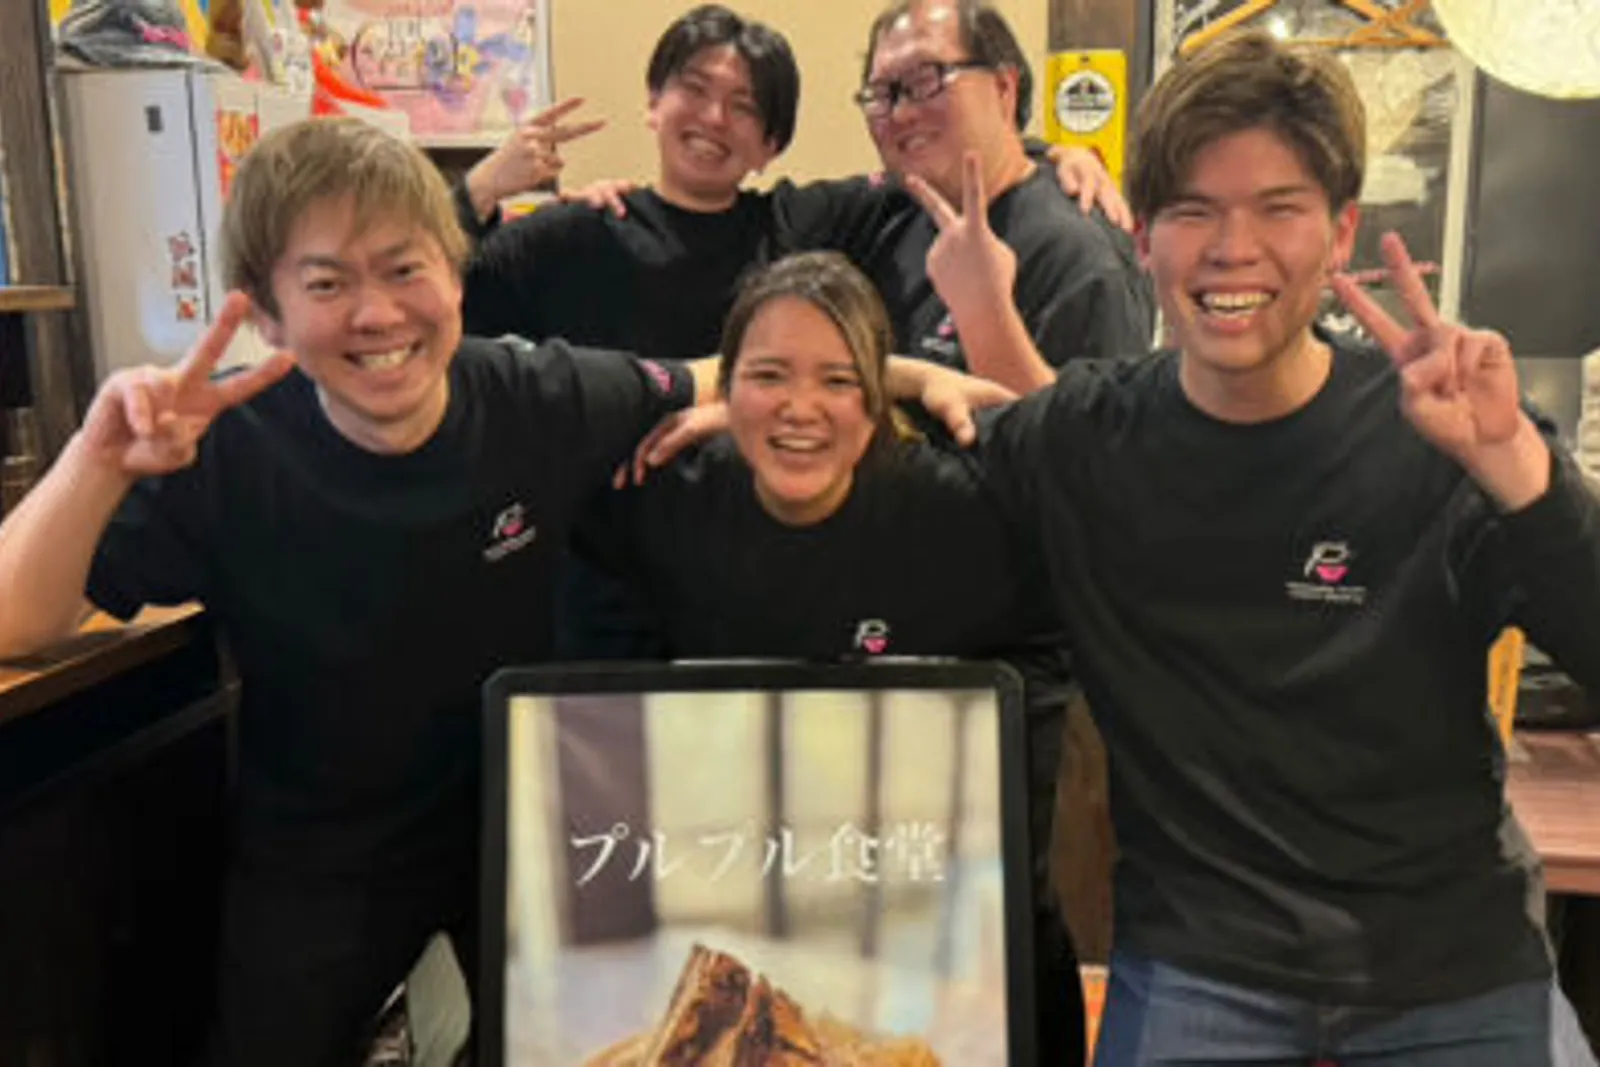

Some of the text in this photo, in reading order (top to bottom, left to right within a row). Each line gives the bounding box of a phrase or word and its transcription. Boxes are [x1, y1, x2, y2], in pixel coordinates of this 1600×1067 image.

[570, 818, 945, 888] プルプル食堂
